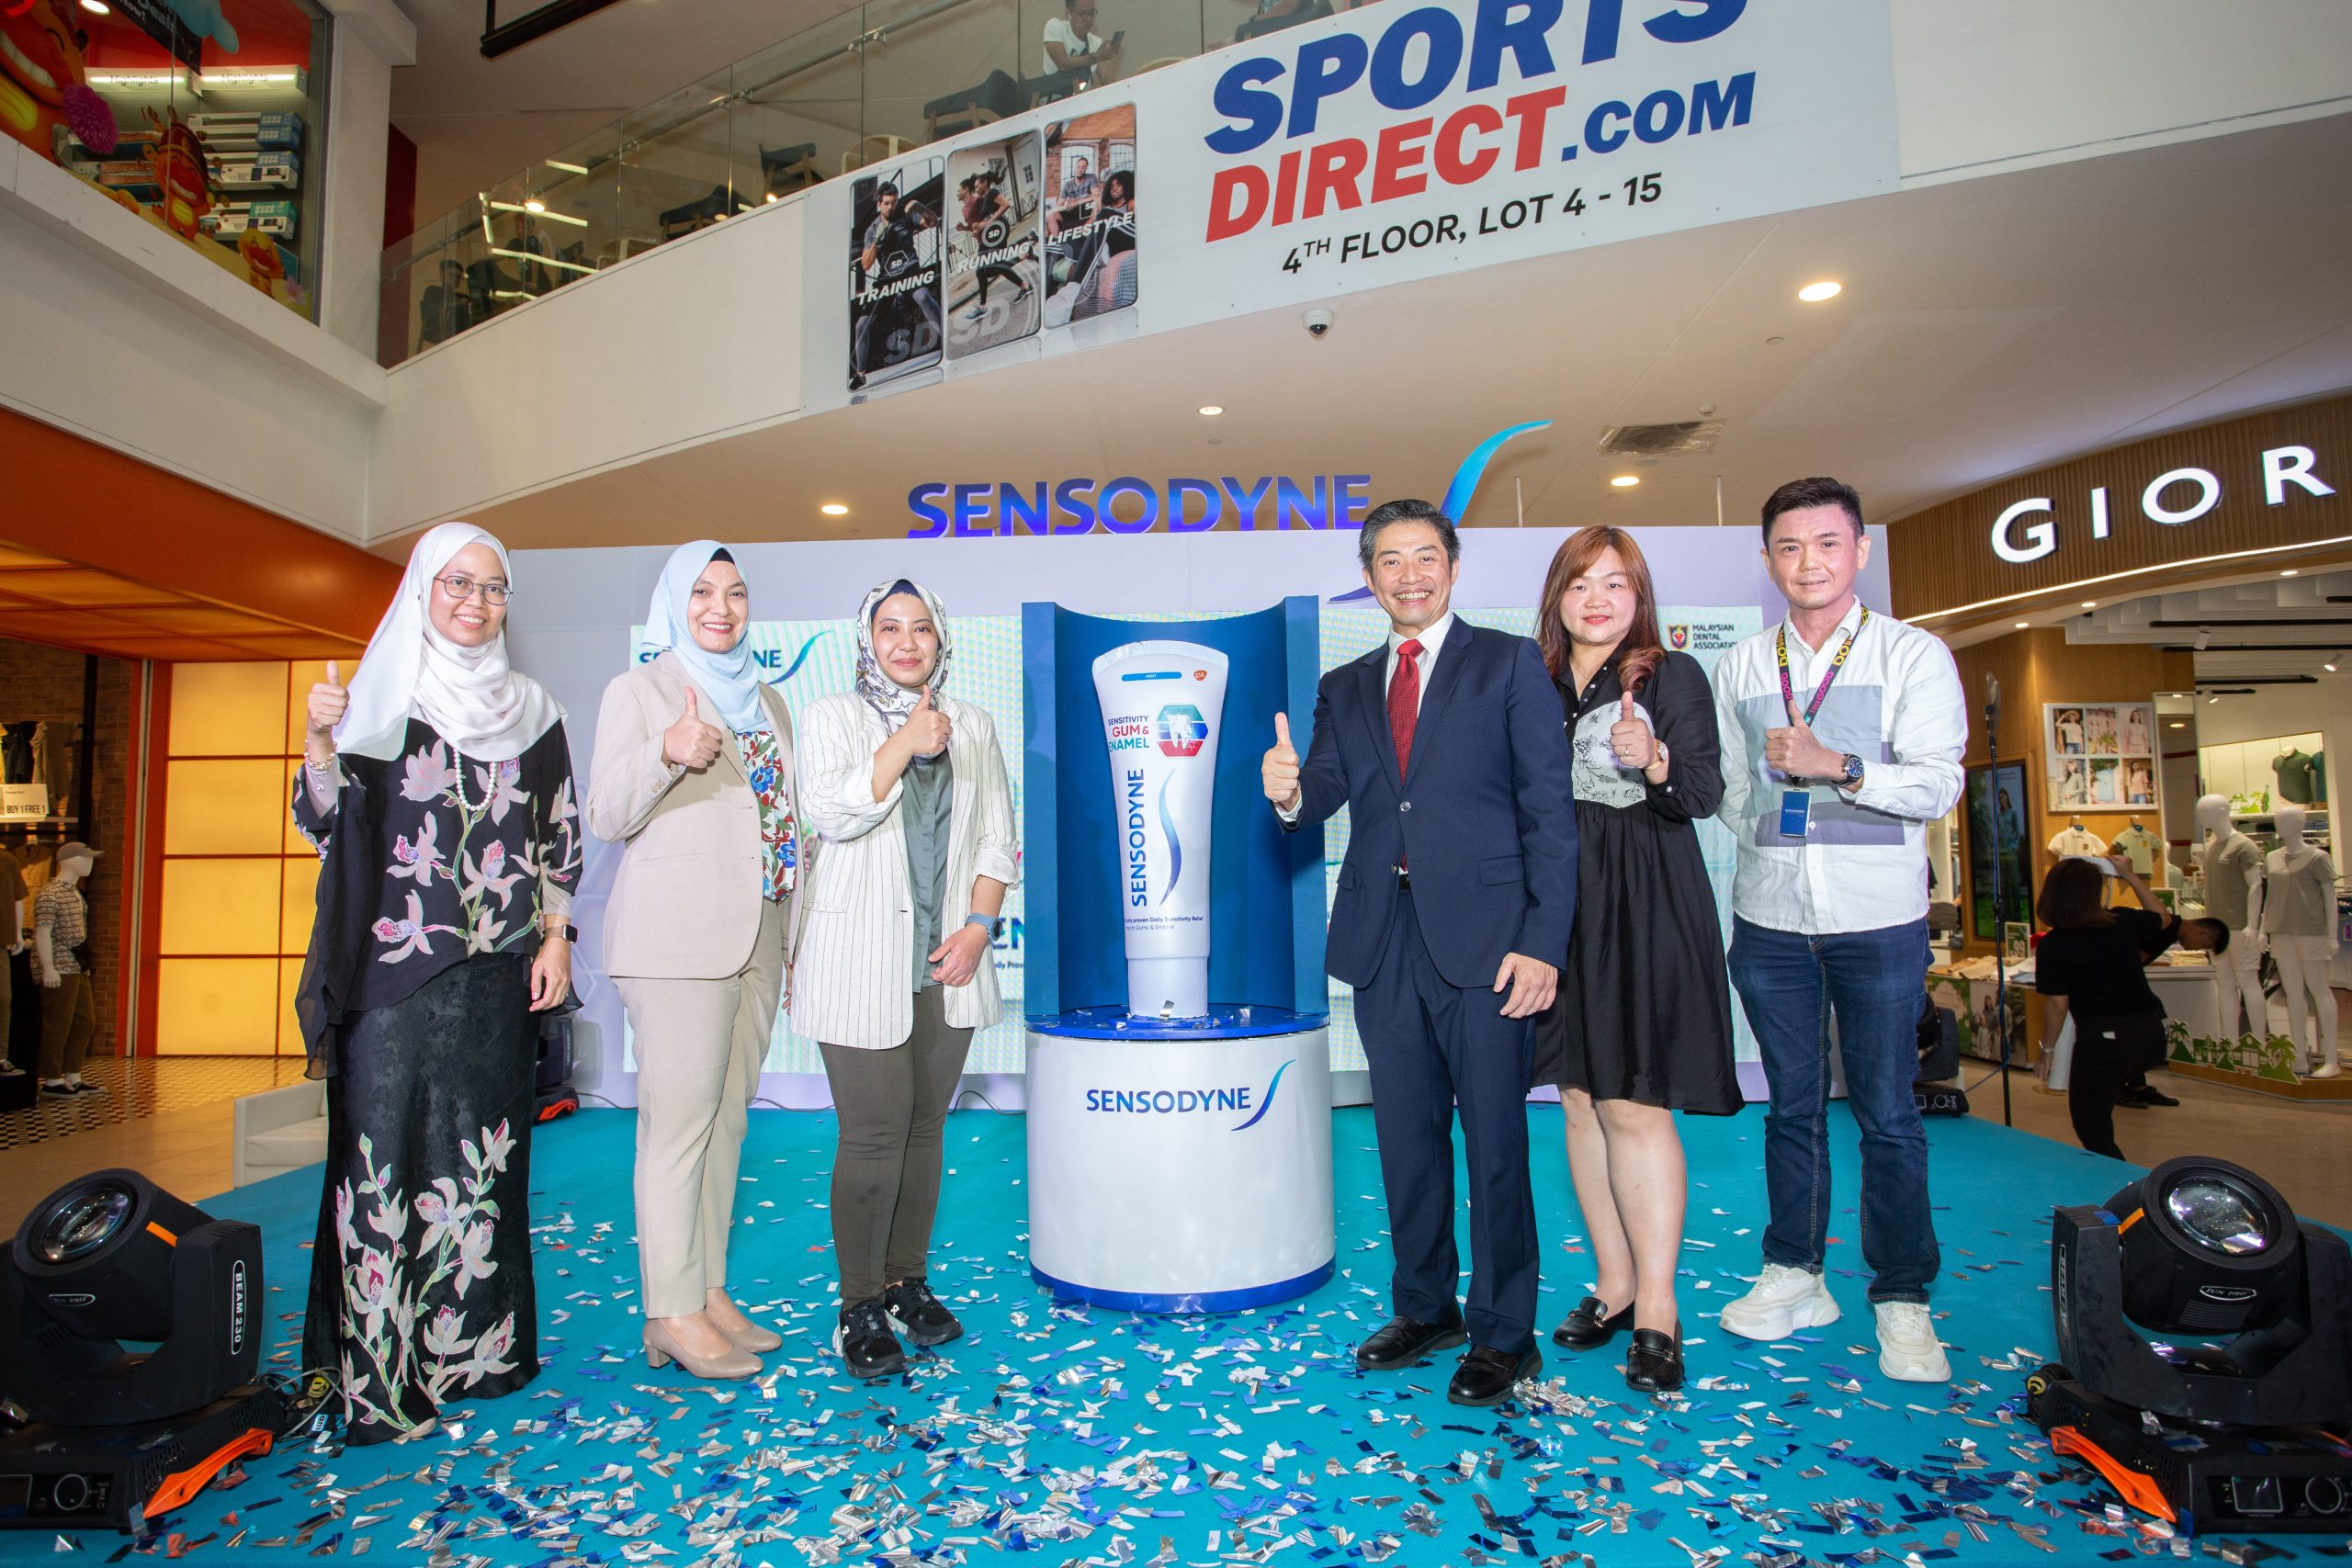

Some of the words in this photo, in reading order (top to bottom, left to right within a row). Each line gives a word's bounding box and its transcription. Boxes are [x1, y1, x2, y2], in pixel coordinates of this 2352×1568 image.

[110, 74, 159, 86] Highlights
[221, 73, 269, 85] Highlights
[1084, 201, 1096, 210] SD
[1047, 211, 1134, 247] LIFESTYLE
[1281, 237, 1331, 275] 4TH
[1340, 214, 1467, 265] FLOOR,
[1477, 193, 1555, 235] LOT
[1562, 187, 1587, 217] 4
[1623, 172, 1663, 207] 15
[988, 228, 1001, 240] SD
[890, 259, 903, 268] SD
[956, 242, 1031, 275] RUNNING
[858, 271, 935, 306] TRAINING
[907, 474, 1372, 540] SENSODYNE
[1991, 446, 2336, 564] GIOR
[1693, 633, 1722, 641] DENTAL
[1693, 641, 1738, 649] ASSOCIATIO
[1107, 715, 1149, 726] SENSITIVITY
[1112, 725, 1140, 738] GUM
[1142, 726, 1149, 735] &
[6, 805, 19, 814] BUY
[20, 805, 24, 814] 1
[25, 805, 41, 814] FREE
[1127, 768, 1148, 908] SENSODYNE
[1085, 1087, 1252, 1114] SENSODYNE
[234, 1272, 243, 1314] BEAM
[234, 1317, 243, 1343] 230
